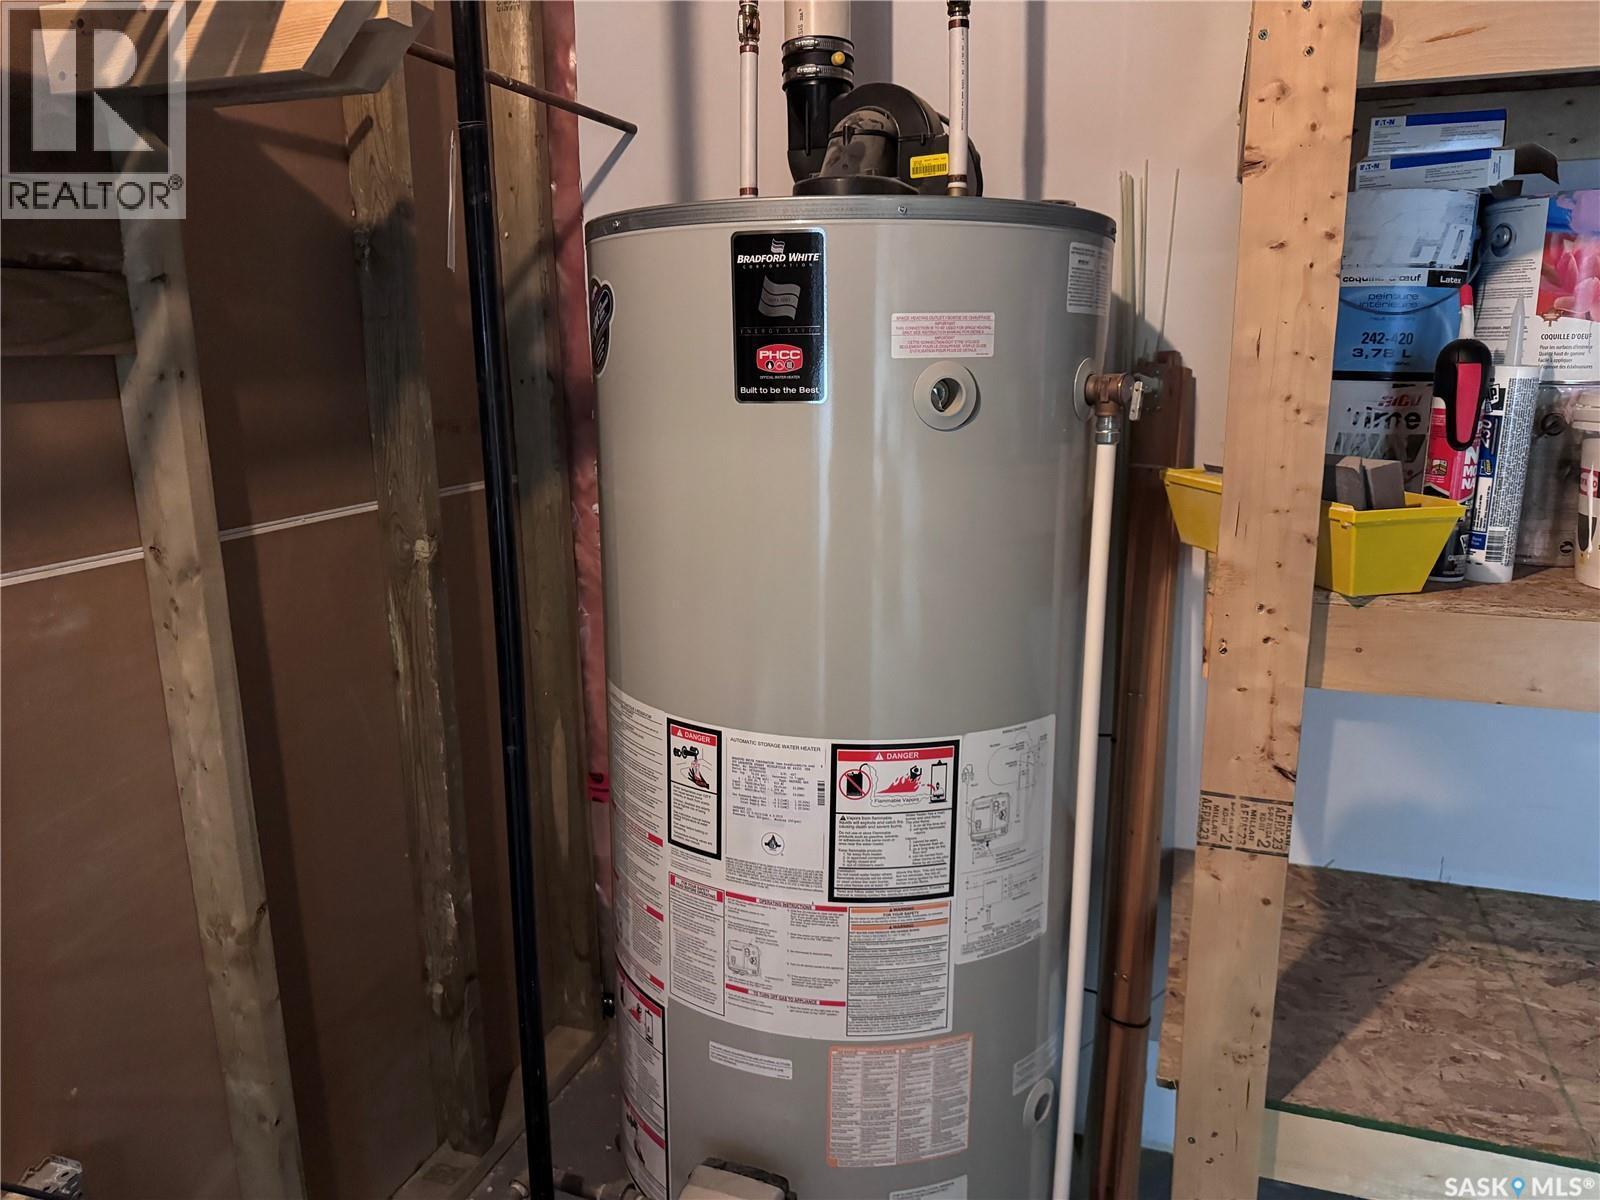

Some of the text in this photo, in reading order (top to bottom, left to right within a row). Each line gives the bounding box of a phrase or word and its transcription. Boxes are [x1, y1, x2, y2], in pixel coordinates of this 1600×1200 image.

[737, 252, 820, 264] BRADFORD WHITE
[1440, 276, 1461, 284] Latex
[760, 350, 801, 360] PHCC
[1402, 348, 1411, 358] L
[684, 730, 711, 744] DANGER
[730, 737, 756, 746] AUTOMATIC
[886, 752, 920, 760] DANGER
[1248, 809, 1257, 842] MILLAR
[1220, 833, 1232, 844] 2
[1272, 837, 1284, 850] 23
[1256, 839, 1272, 849] 2
